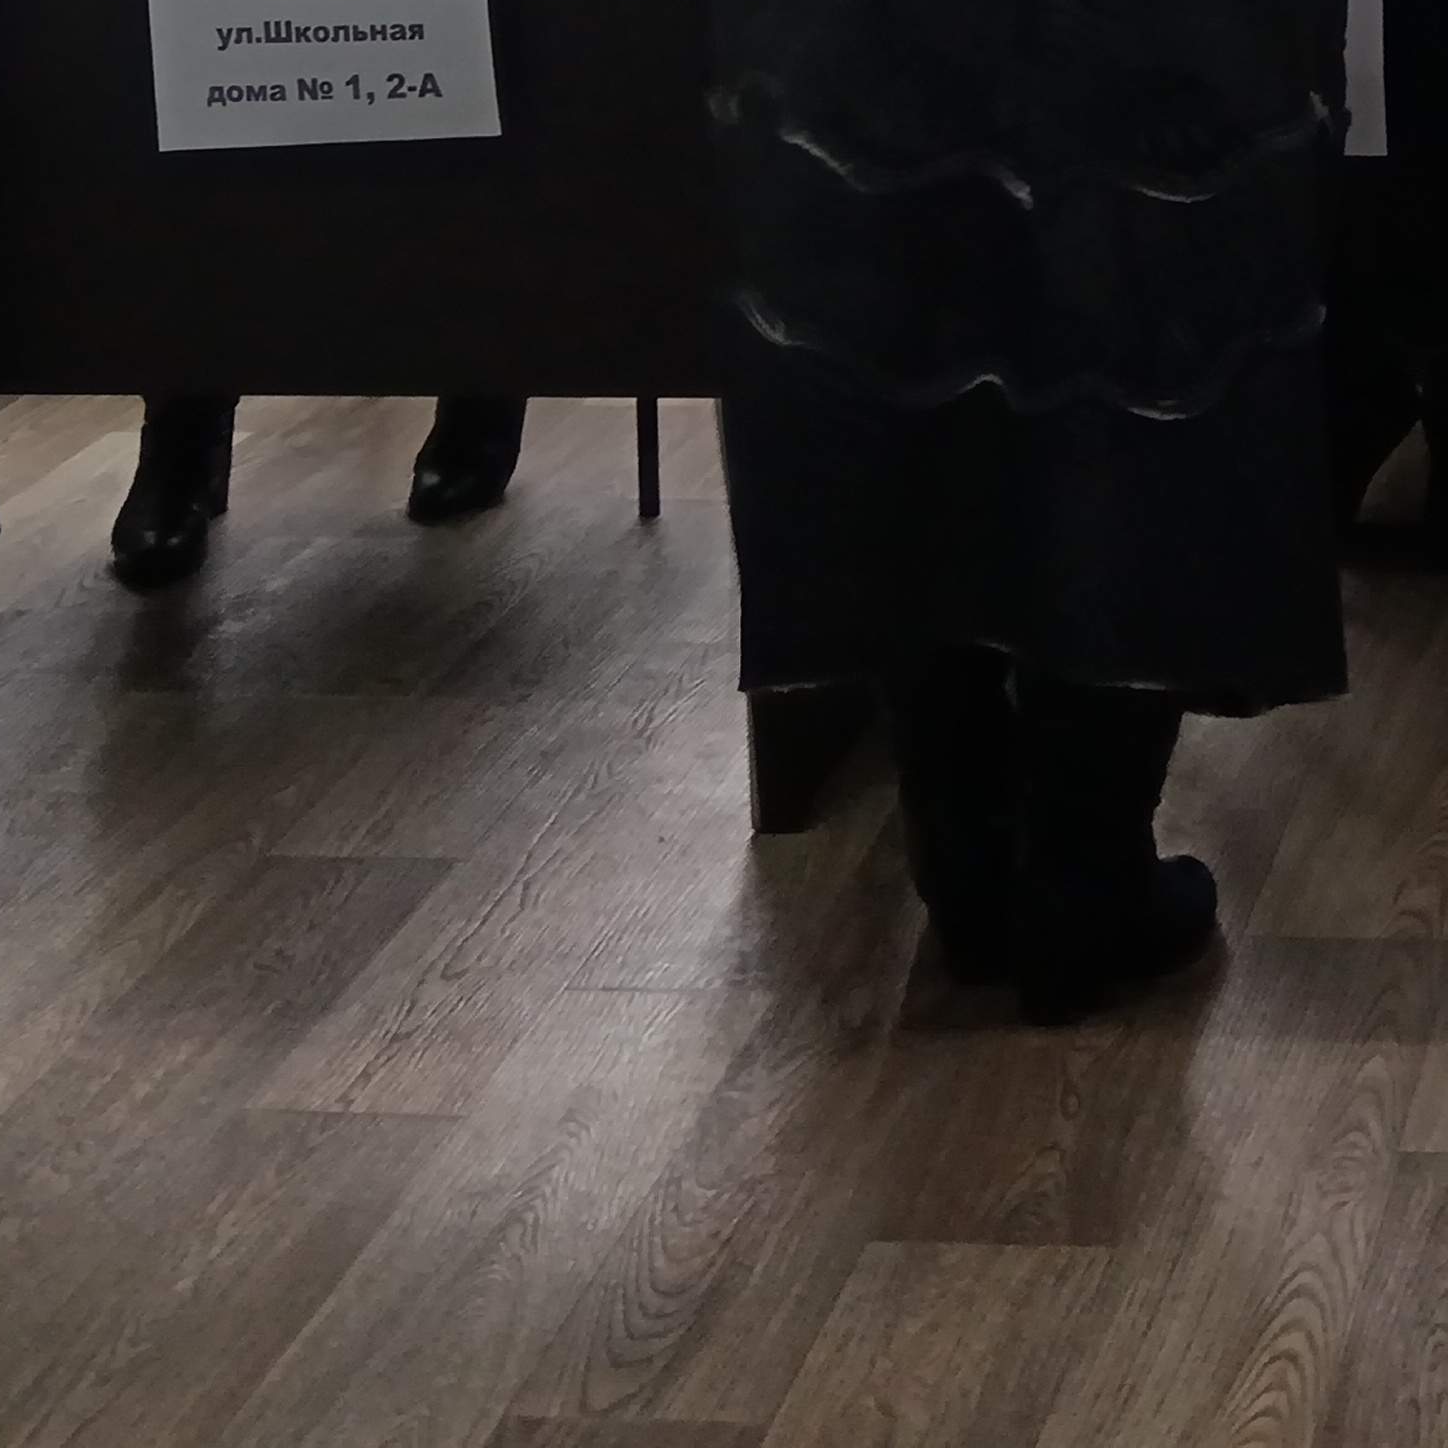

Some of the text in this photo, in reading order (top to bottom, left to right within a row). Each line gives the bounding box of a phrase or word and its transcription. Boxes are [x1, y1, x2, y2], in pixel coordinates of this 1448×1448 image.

[216, 19, 425, 51] ул.Школьная
[206, 73, 443, 107] дома № 1, 2-А
